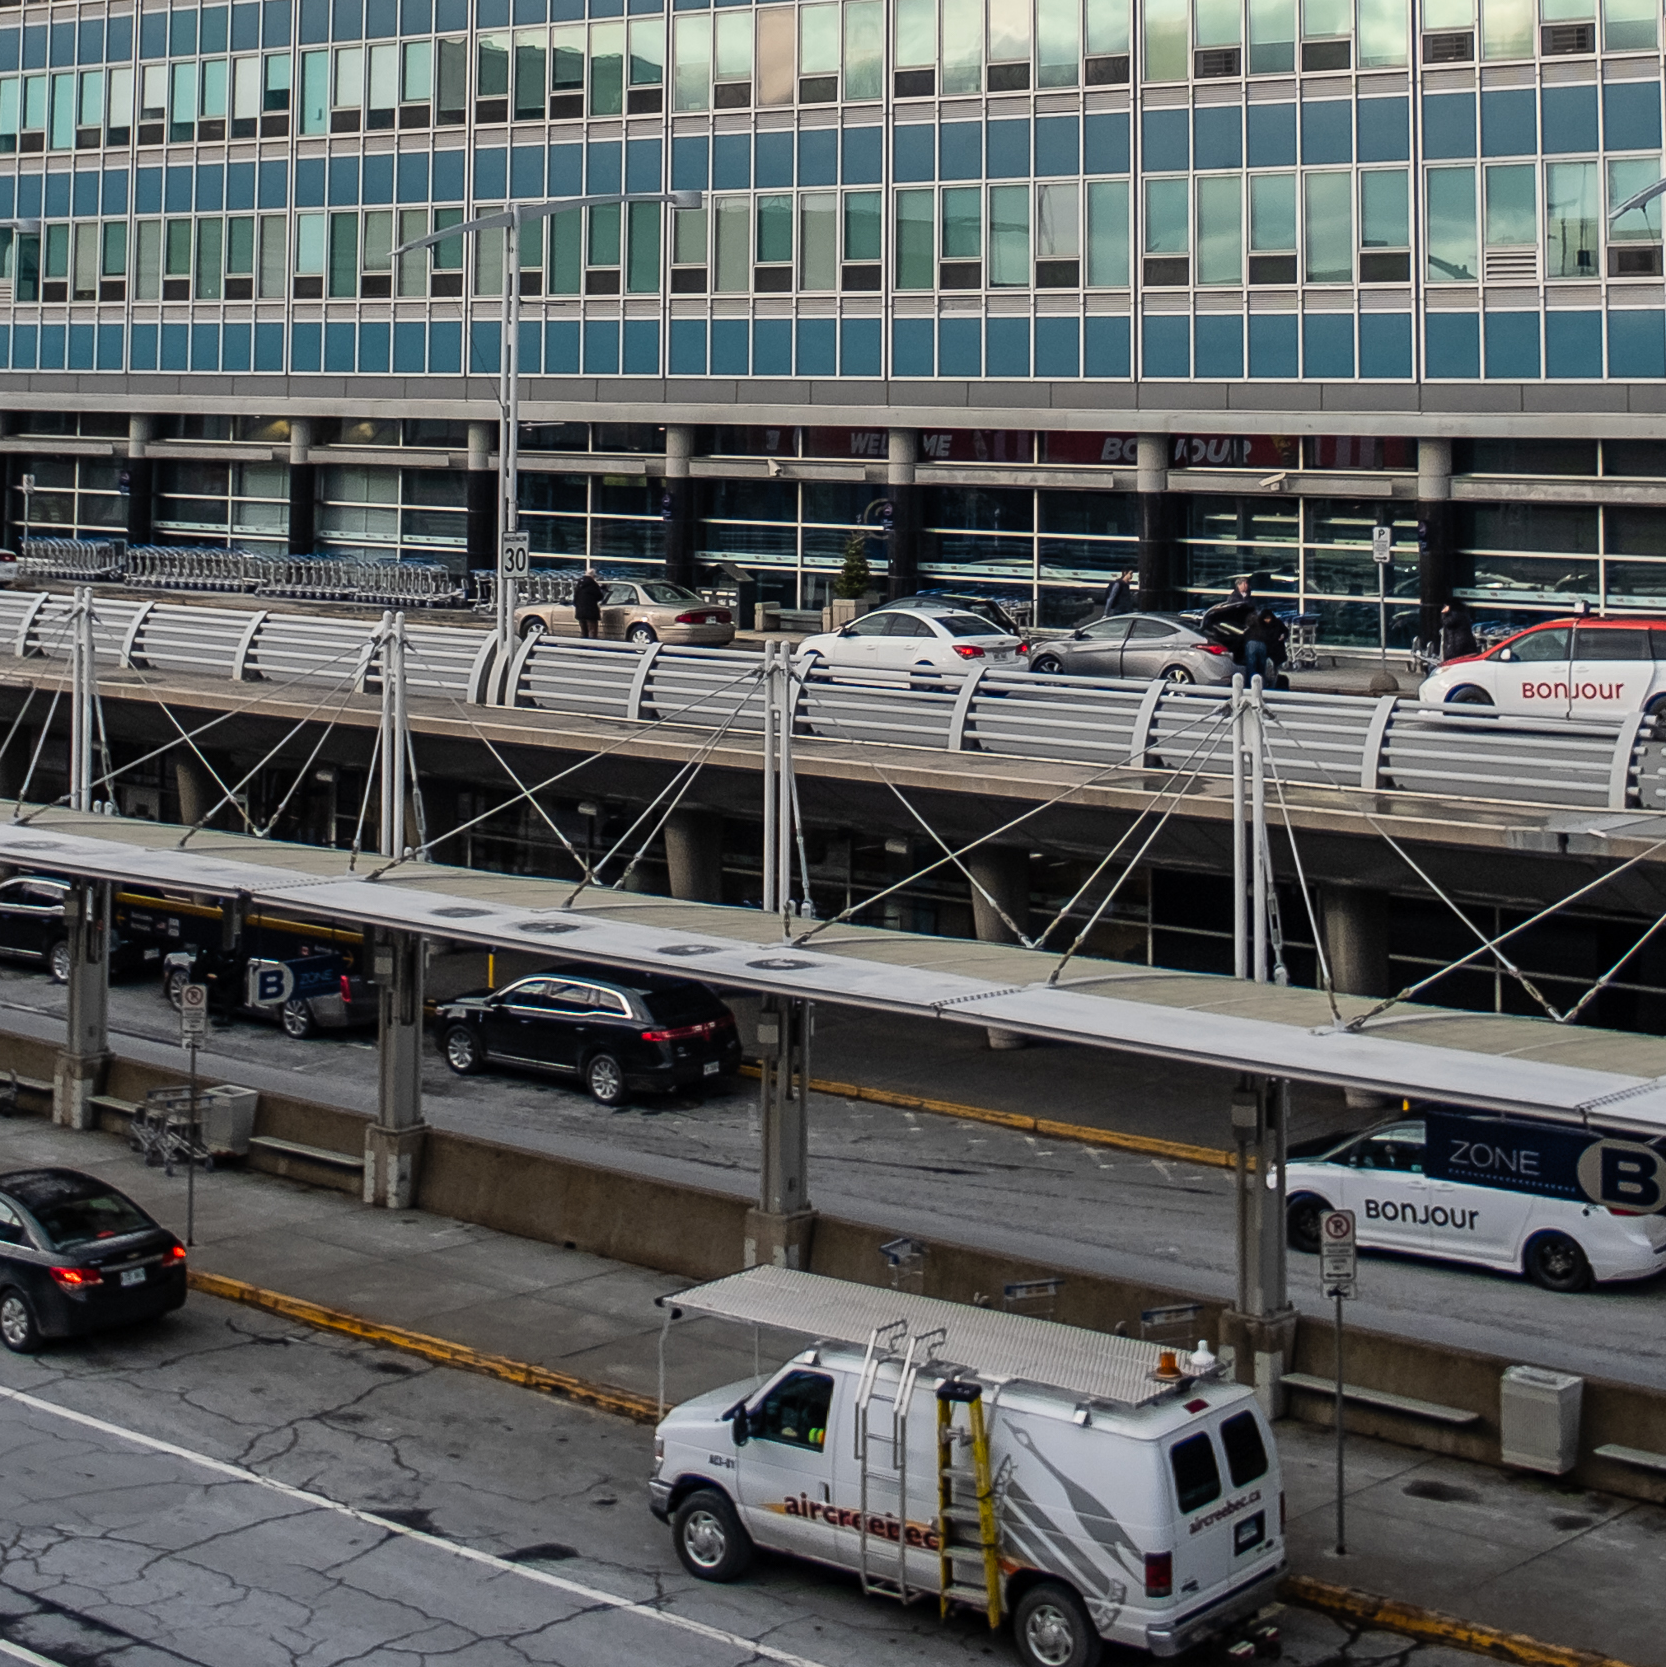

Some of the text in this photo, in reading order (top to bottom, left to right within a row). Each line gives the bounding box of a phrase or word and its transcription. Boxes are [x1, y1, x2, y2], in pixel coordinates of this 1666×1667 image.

[505, 547, 526, 572] 30
[258, 969, 333, 1001] B ZONE
[1449, 1139, 1541, 1176] ZONE
[1601, 1147, 1660, 1207] B
